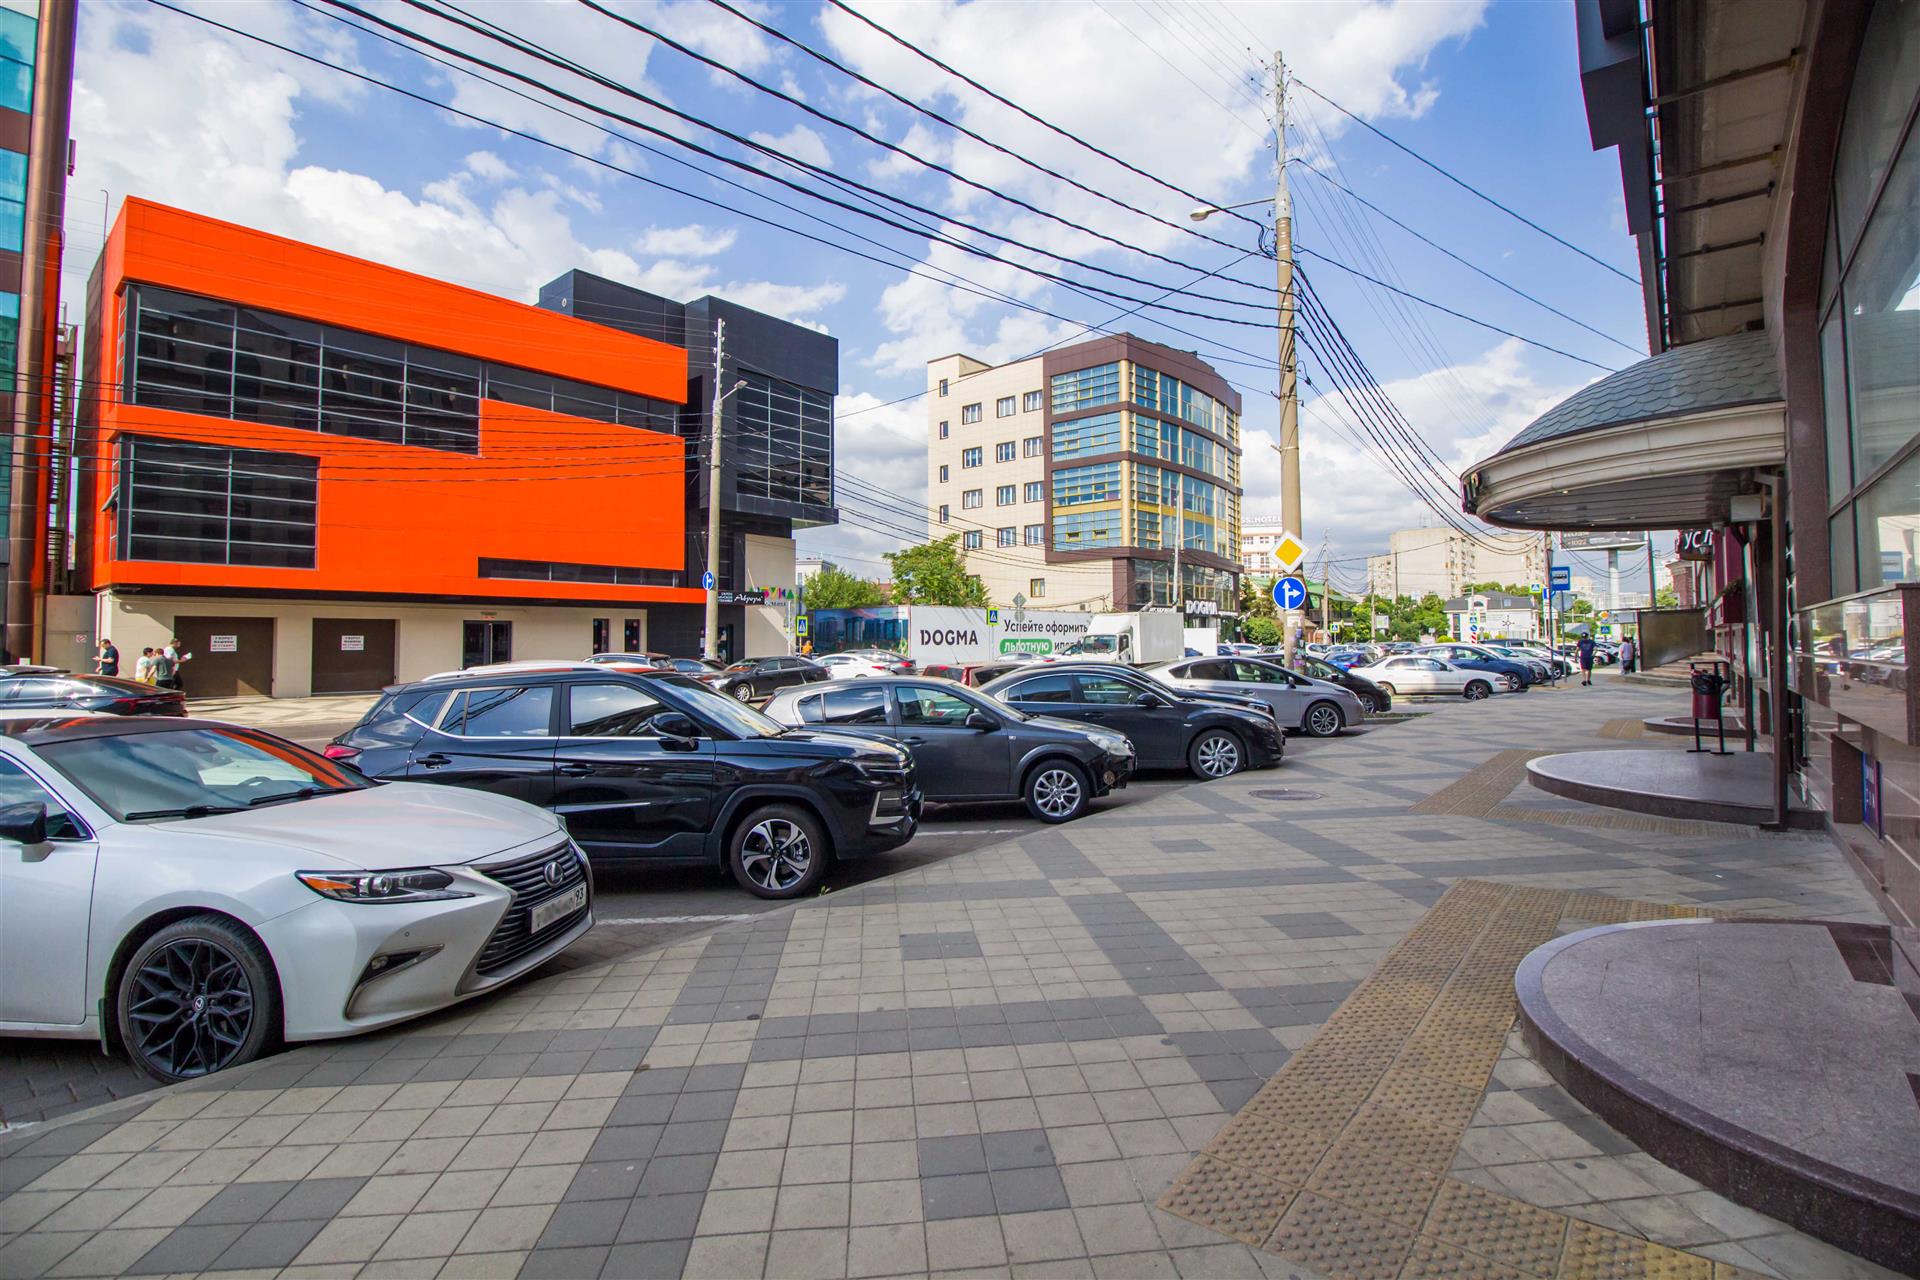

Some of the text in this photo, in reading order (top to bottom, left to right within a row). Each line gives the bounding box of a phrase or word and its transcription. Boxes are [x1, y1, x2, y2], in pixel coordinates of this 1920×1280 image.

[1185, 600, 1218, 615] DOGMA
[1004, 619, 1088, 635] Успейте оформить
[920, 629, 978, 646] DOGMA
[575, 887, 584, 902] 93
